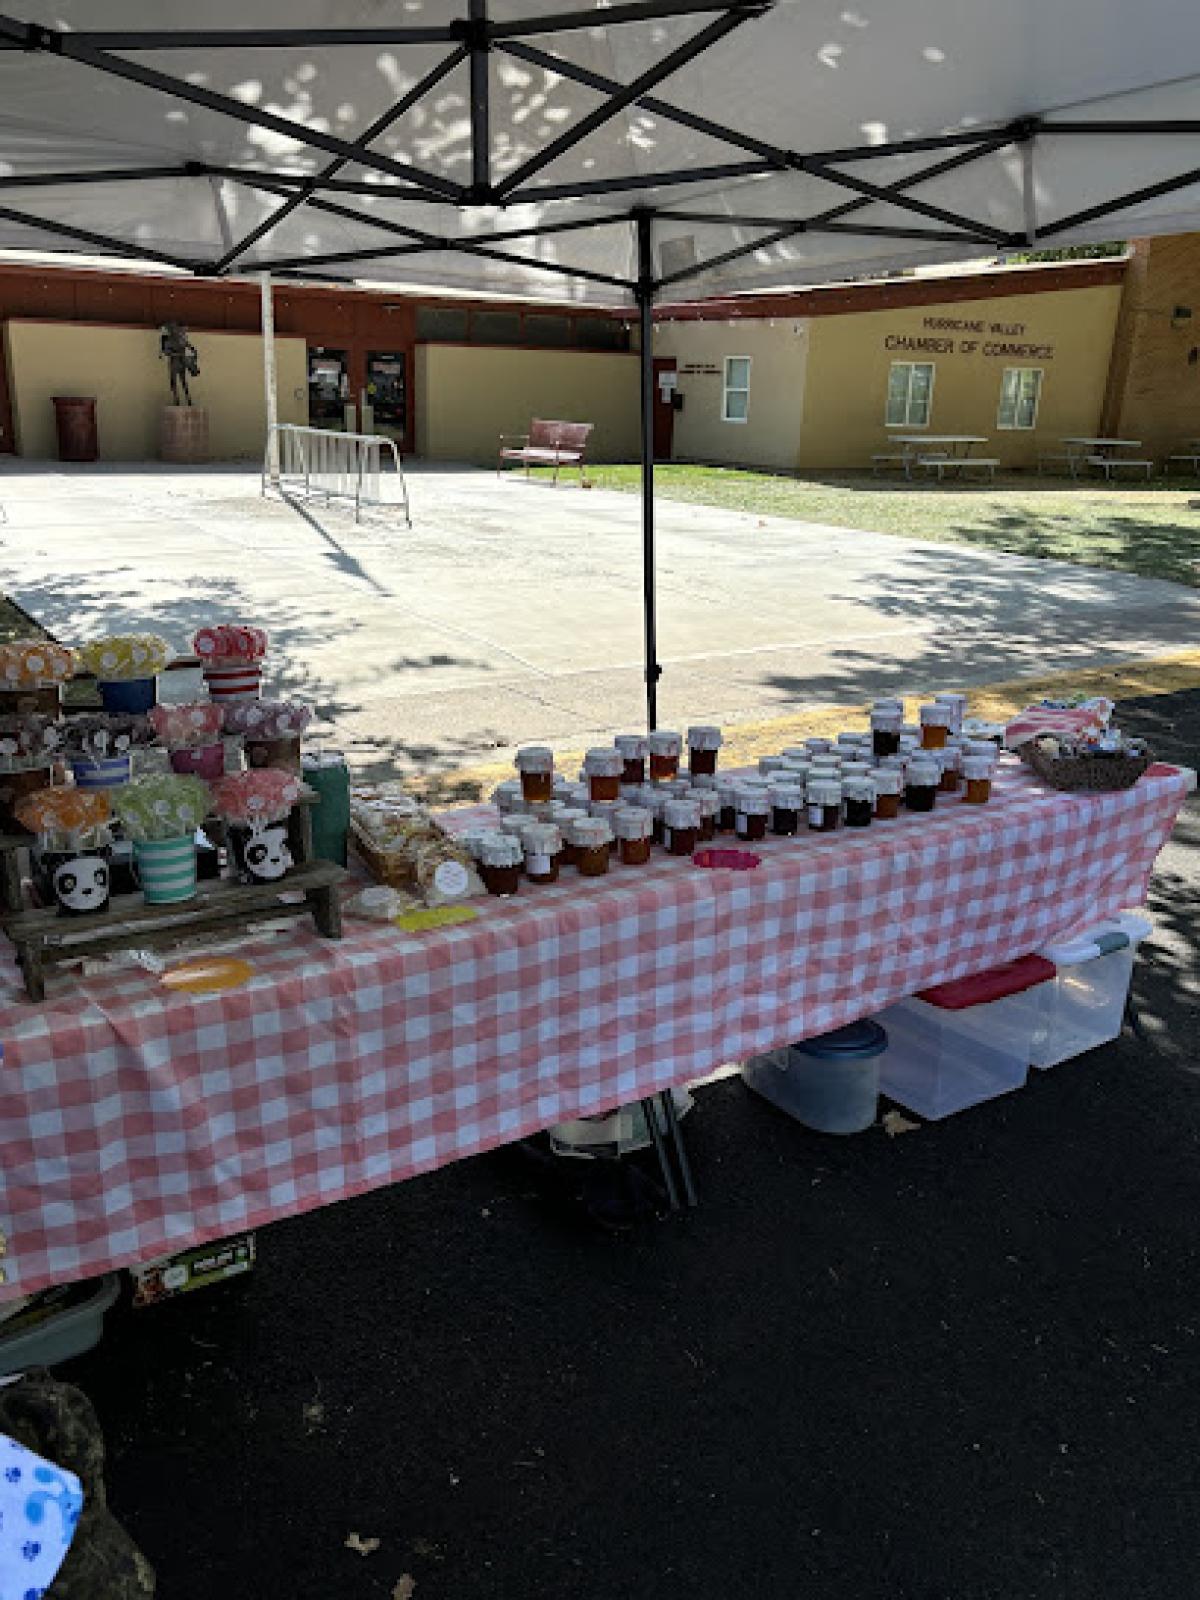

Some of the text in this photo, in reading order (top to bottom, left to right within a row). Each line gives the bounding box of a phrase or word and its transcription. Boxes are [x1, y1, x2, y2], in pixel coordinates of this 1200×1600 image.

[923, 317, 1026, 336] HURRICANE VALLEY
[884, 335, 1054, 360] CHAMBER OF COMMERCE
